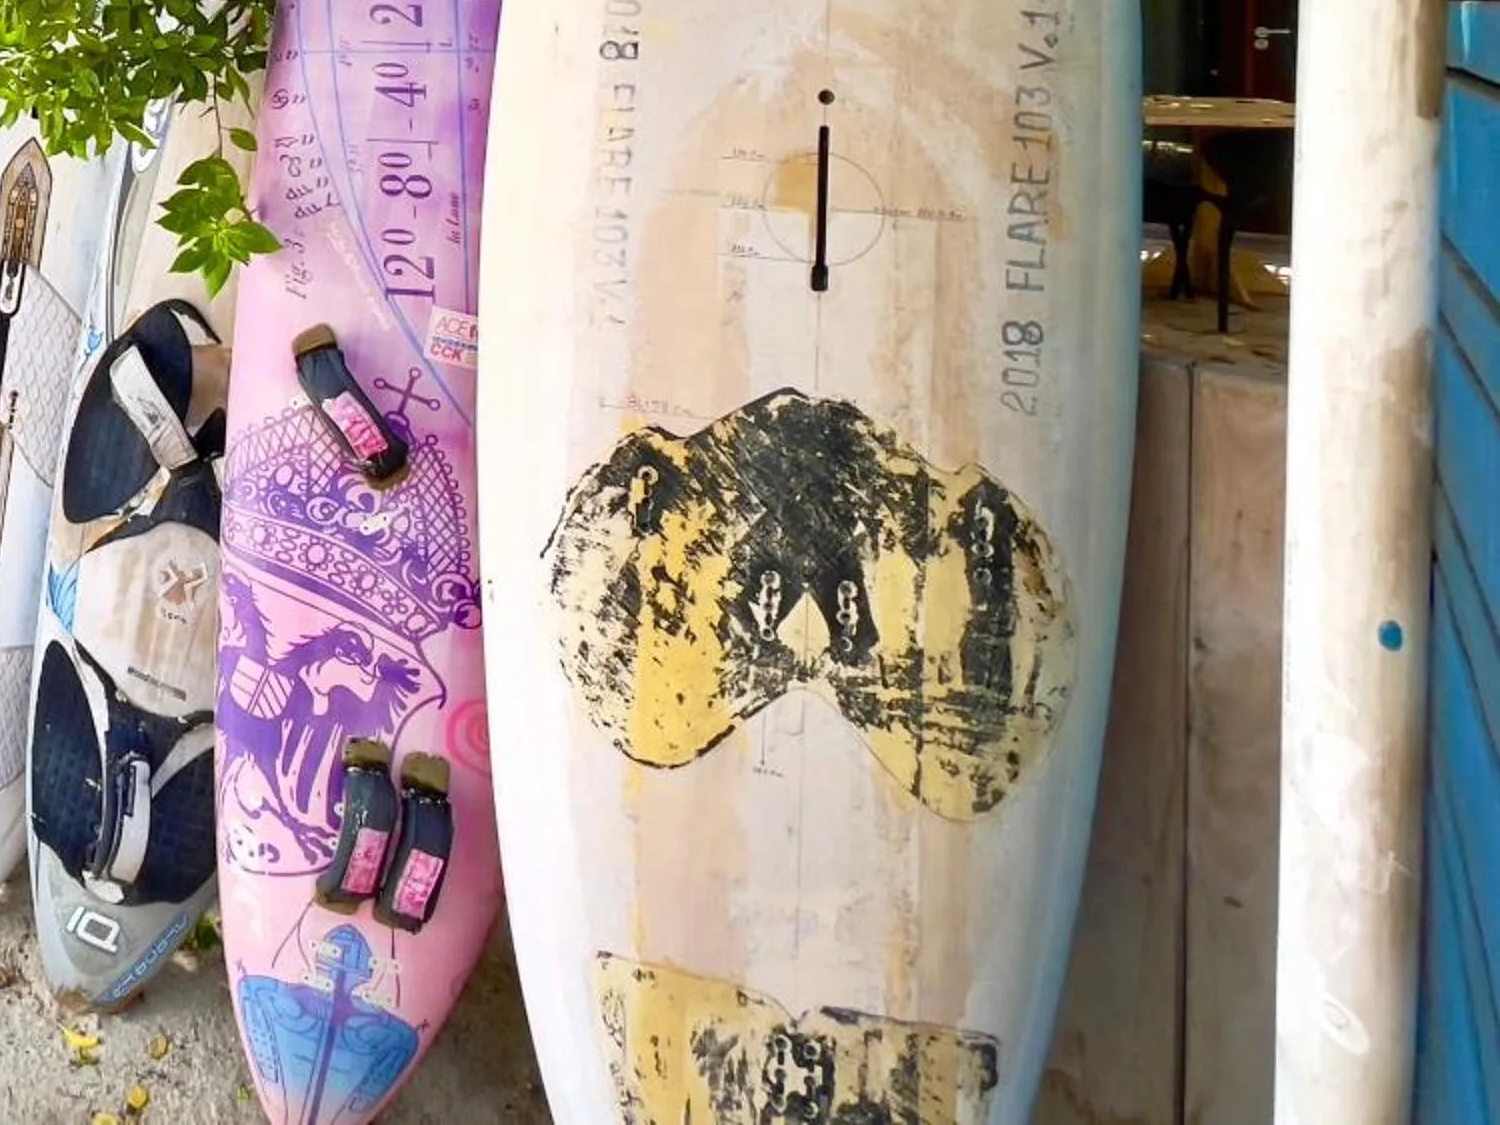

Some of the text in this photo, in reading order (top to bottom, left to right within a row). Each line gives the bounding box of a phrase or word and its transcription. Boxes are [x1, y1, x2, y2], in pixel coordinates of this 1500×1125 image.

[1011, 83, 1054, 151] 103
[1004, 161, 1051, 293] FLARE
[999, 320, 1045, 418] 2018
